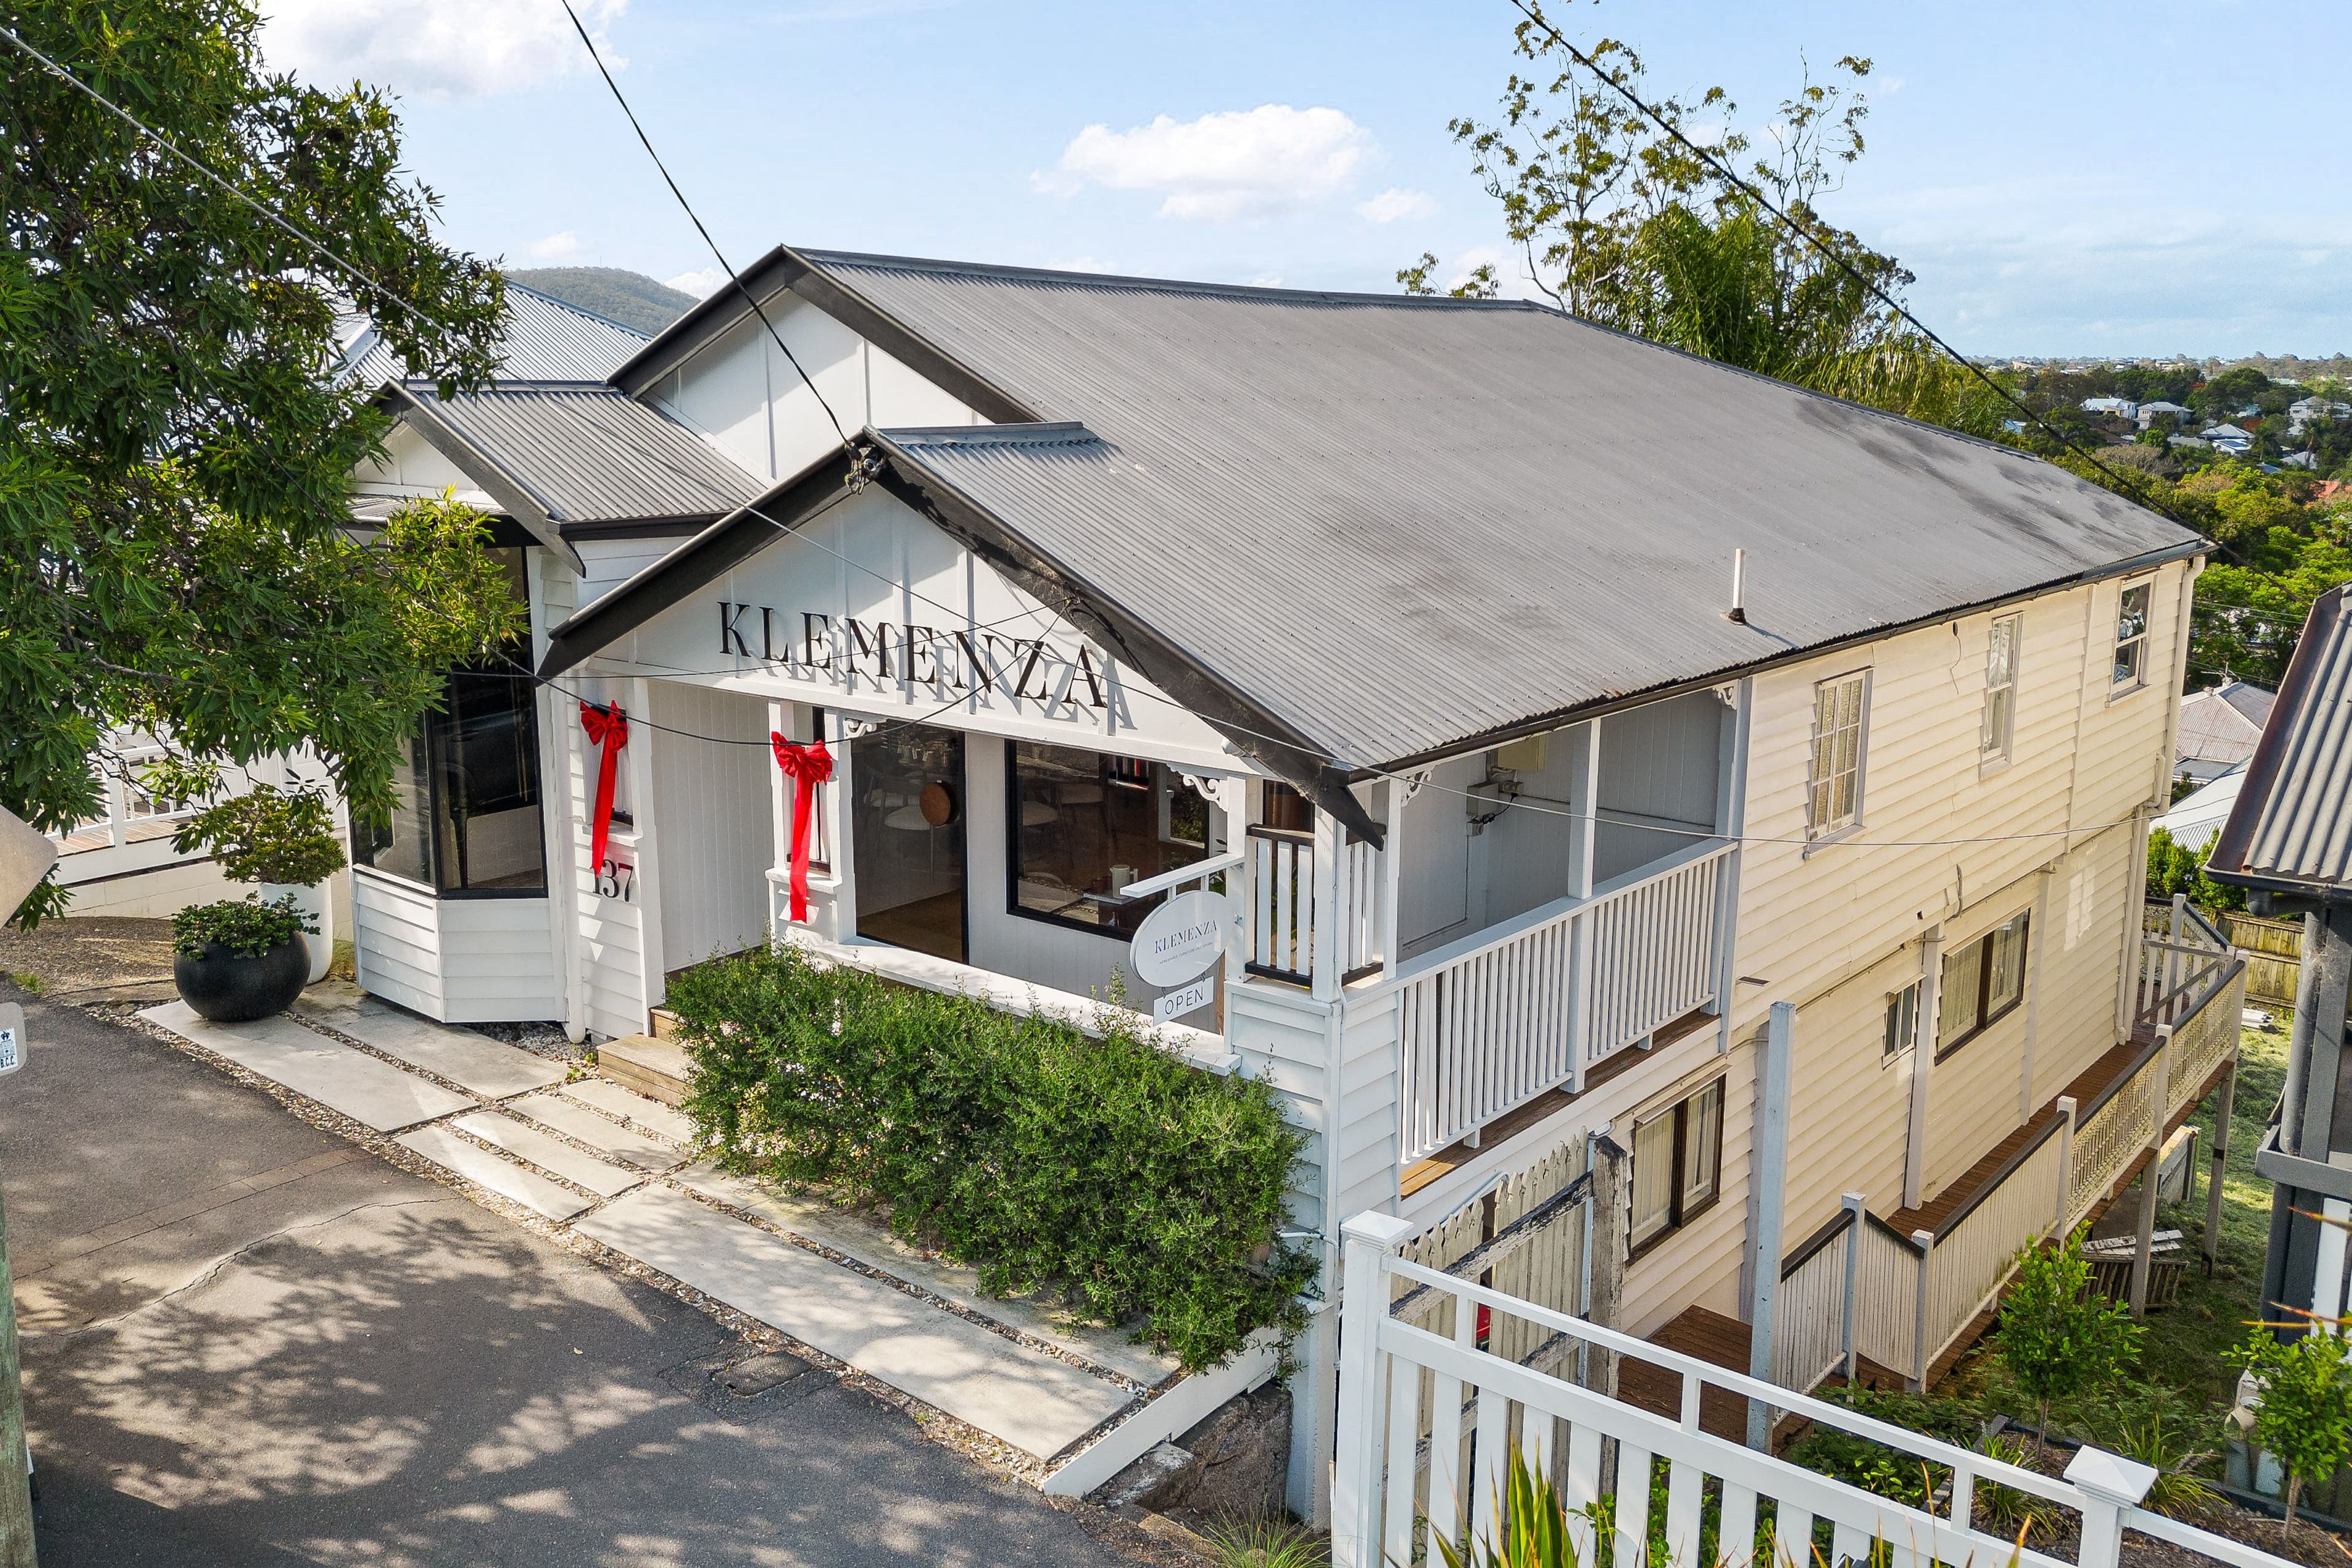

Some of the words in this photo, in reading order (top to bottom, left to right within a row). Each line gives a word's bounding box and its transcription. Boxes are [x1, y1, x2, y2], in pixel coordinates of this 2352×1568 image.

[717, 601, 1107, 707] KLEMENZA
[589, 859, 633, 902] 137
[1155, 920, 1217, 953] KLEMENZA
[1165, 987, 1204, 1014] OPEN
